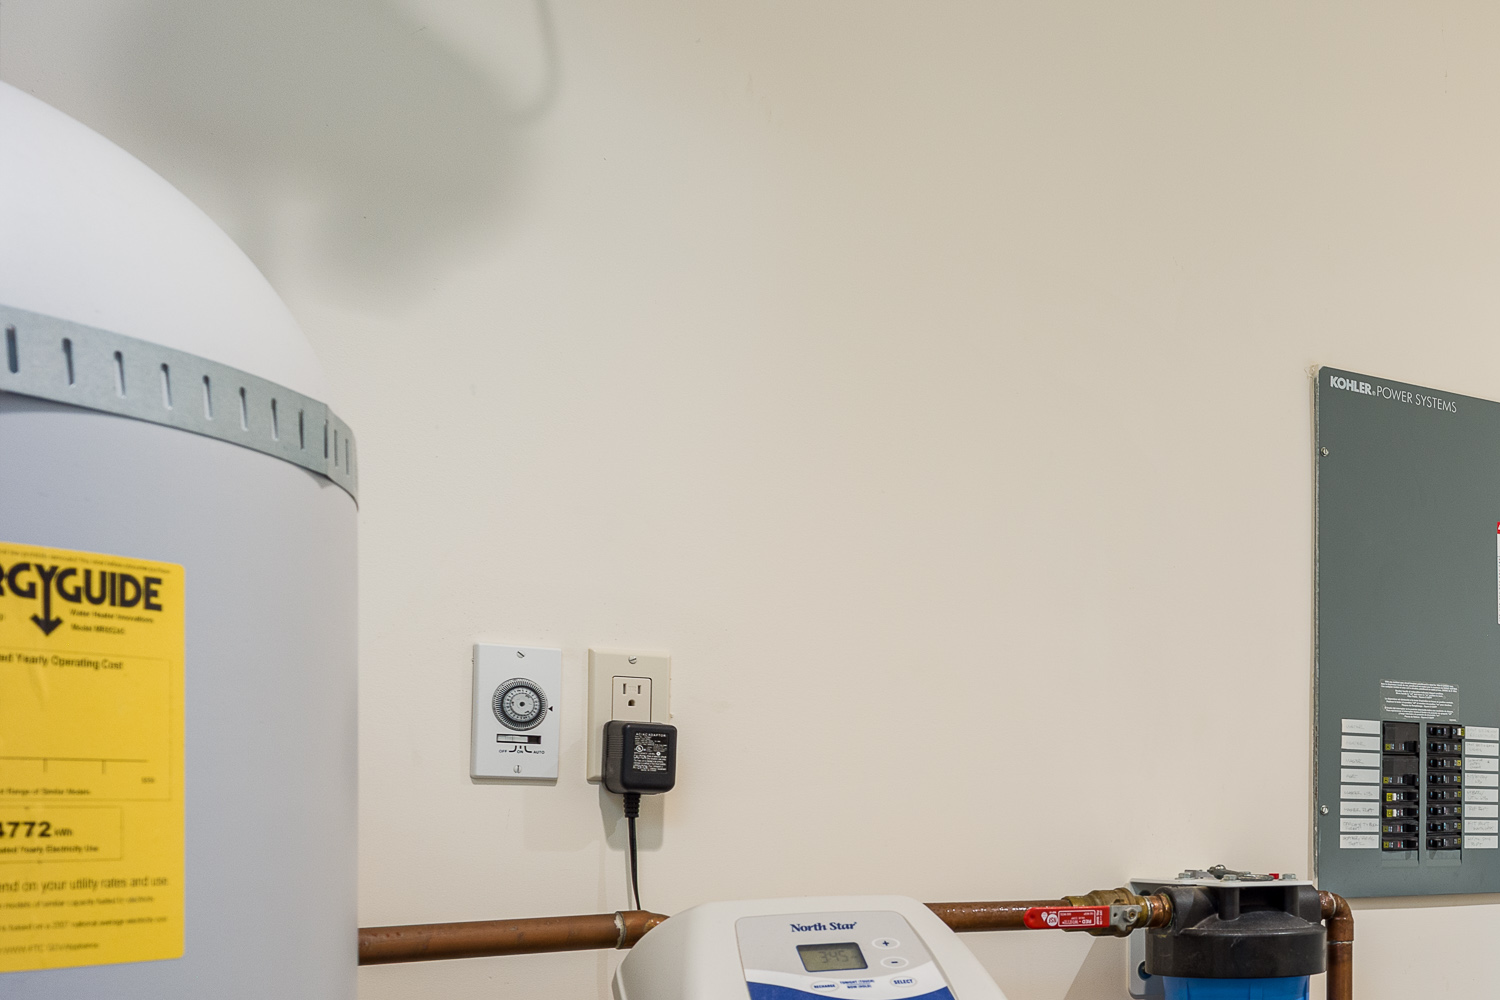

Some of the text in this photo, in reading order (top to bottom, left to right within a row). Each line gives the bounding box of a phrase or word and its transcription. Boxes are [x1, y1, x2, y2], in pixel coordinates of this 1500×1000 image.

[1376, 385, 1413, 403] POWER
[1415, 394, 1457, 413] SYSTEMS
[0, 561, 163, 612] GYGUIDE
[16, 654, 48, 665] Yearly
[51, 655, 99, 669] Operating
[101, 658, 123, 669] Cost
[790, 922, 827, 932] North
